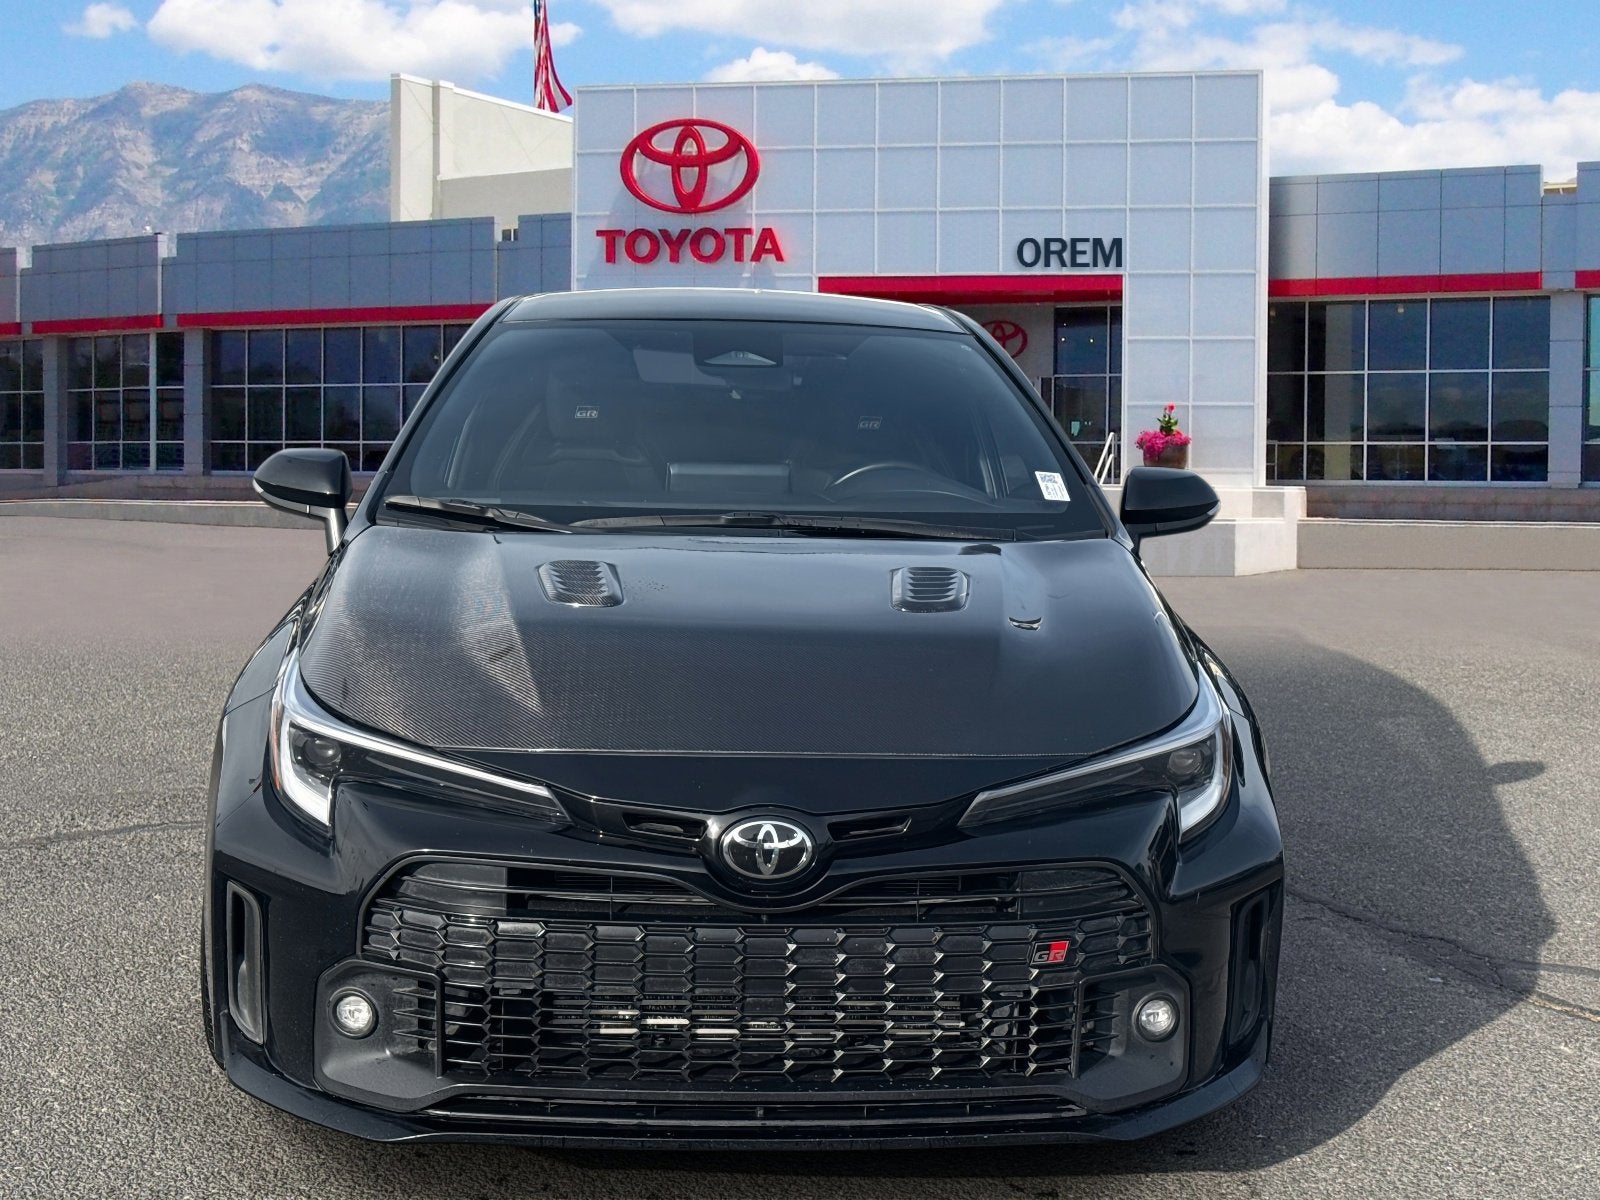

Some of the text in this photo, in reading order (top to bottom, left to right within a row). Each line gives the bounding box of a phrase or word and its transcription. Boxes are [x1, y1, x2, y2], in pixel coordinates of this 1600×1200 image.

[596, 227, 785, 264] TOYOTA
[1017, 238, 1123, 267] OREM
[576, 409, 599, 418] GR
[859, 420, 881, 430] GR
[1033, 949, 1066, 962] GR
